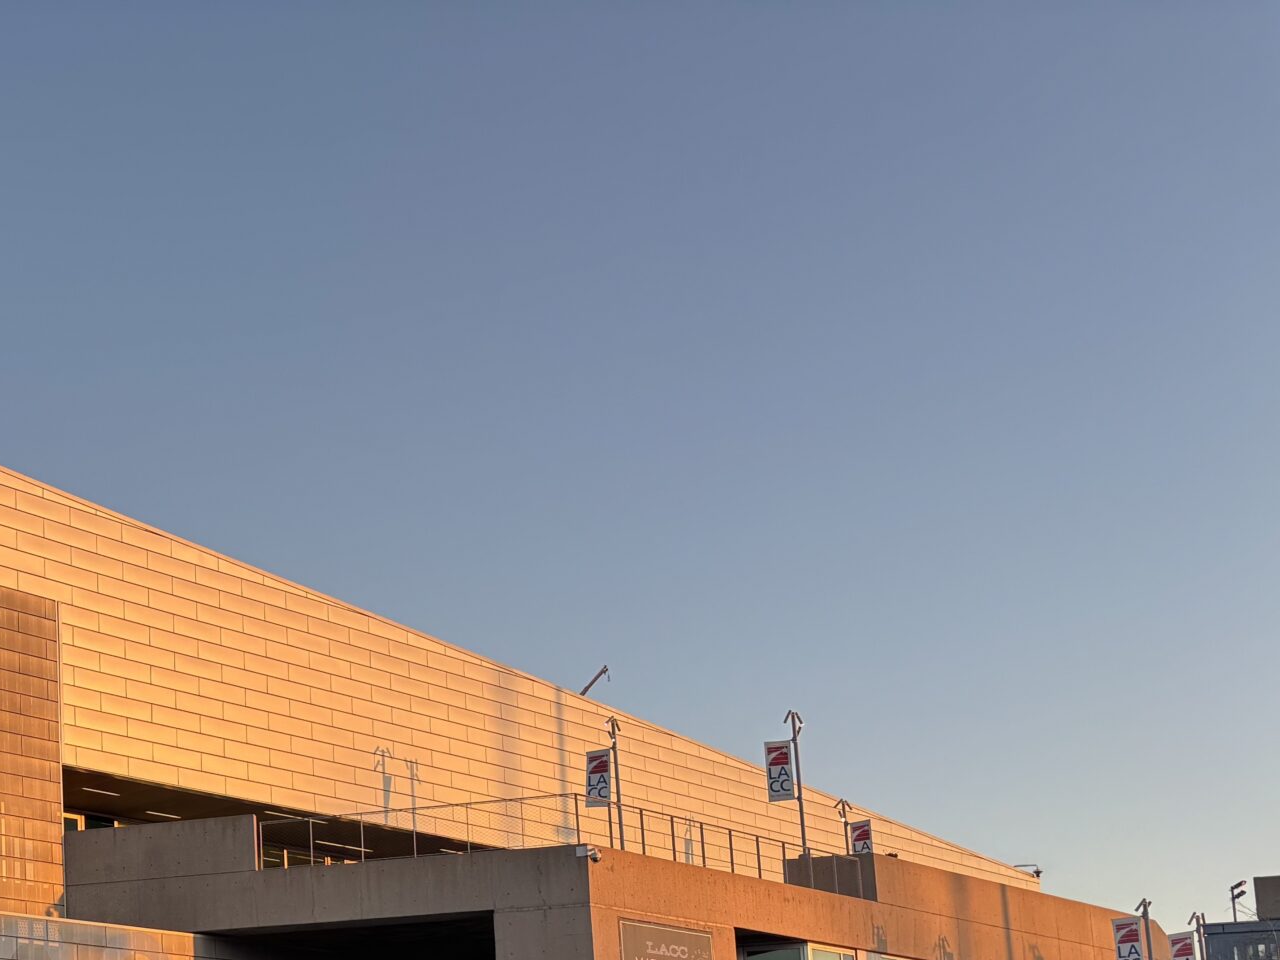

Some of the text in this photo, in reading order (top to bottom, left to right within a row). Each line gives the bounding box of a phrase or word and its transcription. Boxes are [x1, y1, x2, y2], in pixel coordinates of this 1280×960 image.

[768, 766, 790, 780] LA
[588, 774, 608, 787] LA
[769, 779, 791, 793] CC
[852, 841, 871, 853] LA
[645, 941, 688, 959] LACC
[1117, 944, 1141, 959] LA
